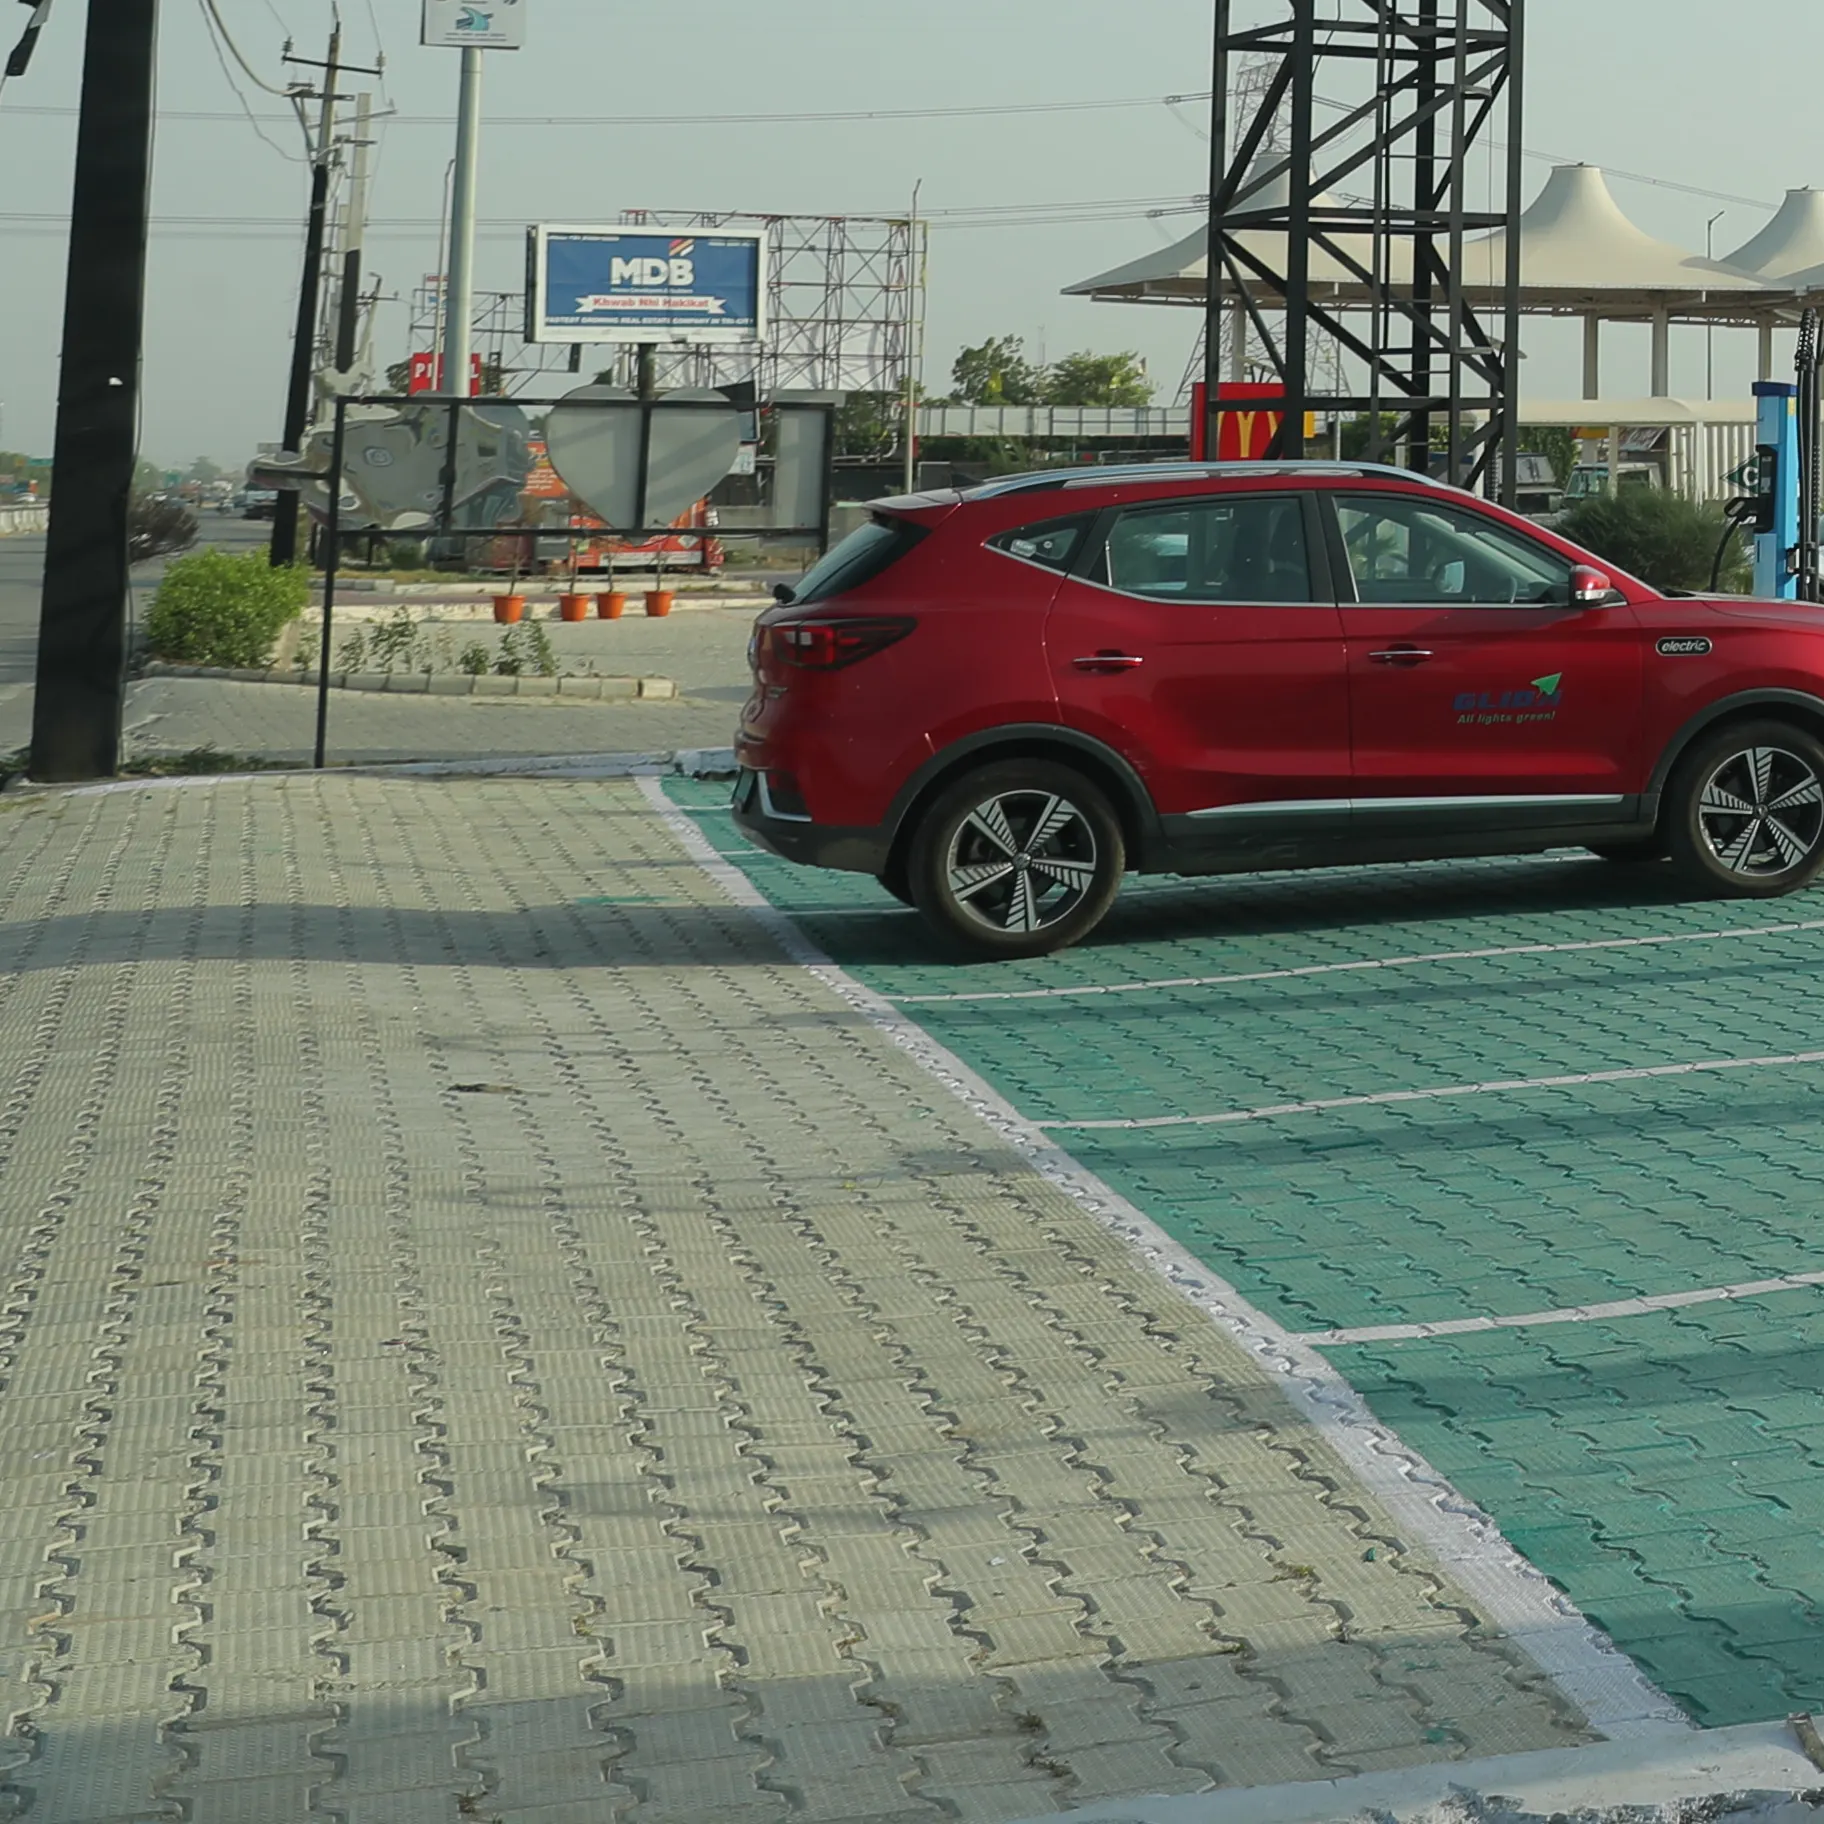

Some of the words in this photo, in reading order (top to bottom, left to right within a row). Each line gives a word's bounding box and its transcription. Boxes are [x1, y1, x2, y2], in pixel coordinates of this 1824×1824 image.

[610, 256, 695, 286] MDB
[1661, 639, 1707, 653] electric
[1453, 688, 1564, 712] GLIDA
[1457, 713, 1474, 725] All
[1478, 713, 1512, 726] lights
[1516, 710, 1556, 725] green!
